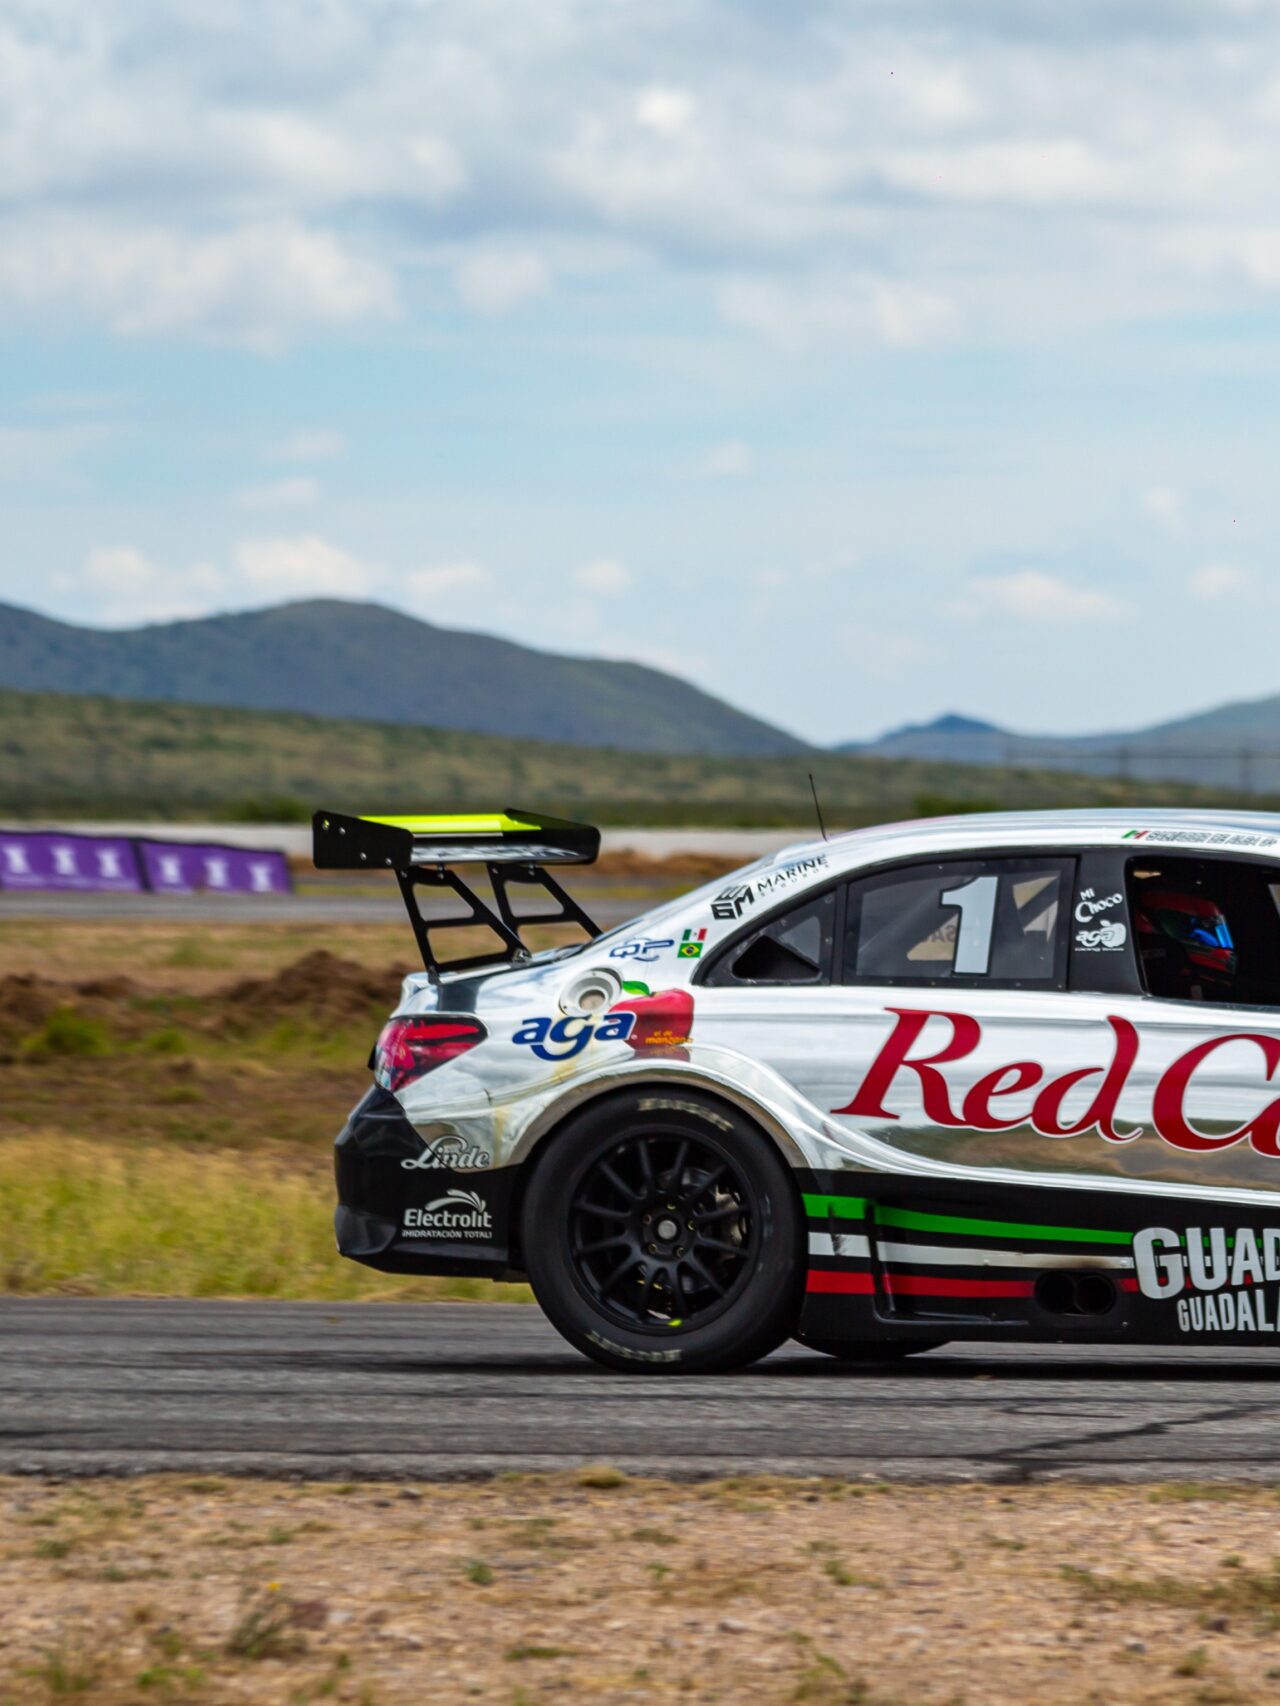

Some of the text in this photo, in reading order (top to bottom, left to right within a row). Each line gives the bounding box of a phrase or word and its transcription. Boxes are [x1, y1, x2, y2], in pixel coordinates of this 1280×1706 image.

[757, 854, 828, 892] MARINE
[941, 875, 998, 974] 1
[1075, 930, 1115, 948] aga
[511, 1012, 638, 1062] aga
[829, 1006, 1144, 1145] Red
[400, 1135, 491, 1170] Linde
[403, 1208, 493, 1228] Electrolit
